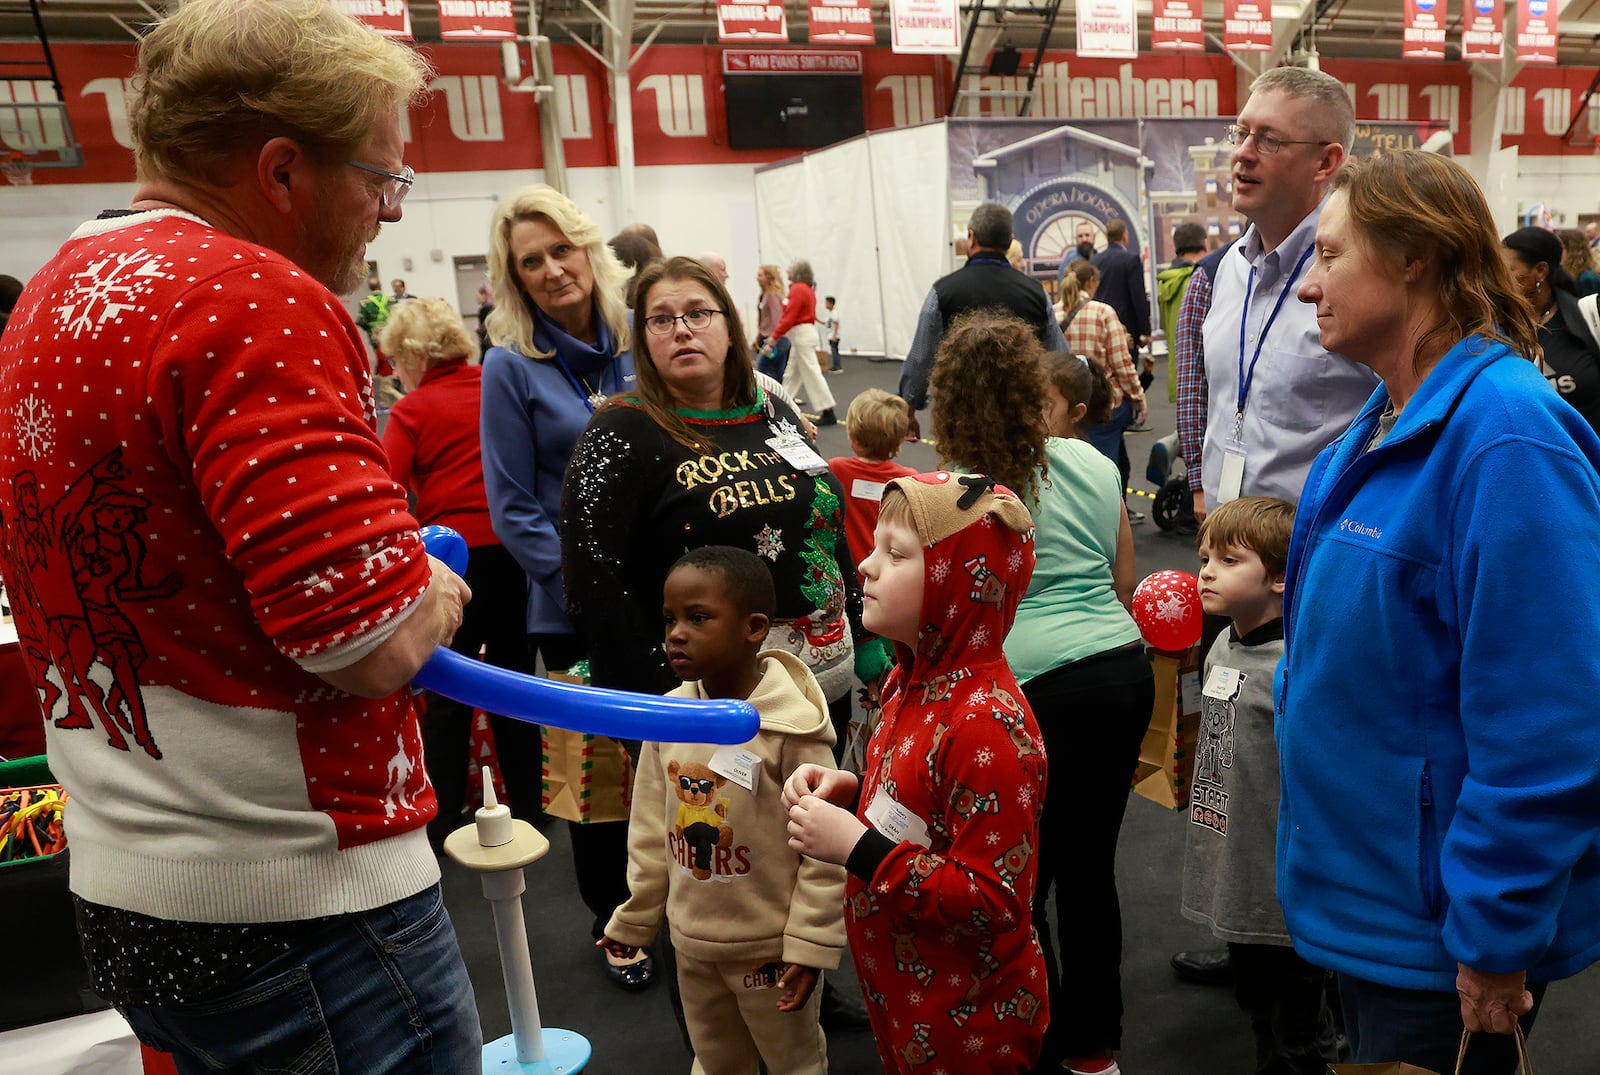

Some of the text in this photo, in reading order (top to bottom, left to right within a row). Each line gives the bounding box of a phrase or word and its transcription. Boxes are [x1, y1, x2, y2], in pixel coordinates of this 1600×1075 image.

[898, 15, 953, 29] CHAMPIONS
[1083, 21, 1131, 34] CHAMPIONS
[749, 55, 858, 70] PAM EVANS SMITH ARENA
[676, 450, 759, 490] ROCK
[708, 474, 796, 519] BELLS
[1347, 520, 1383, 539] Columbia
[732, 767, 748, 778] OLIVER
[1192, 783, 1229, 812] START
[668, 831, 752, 877] CHERS
